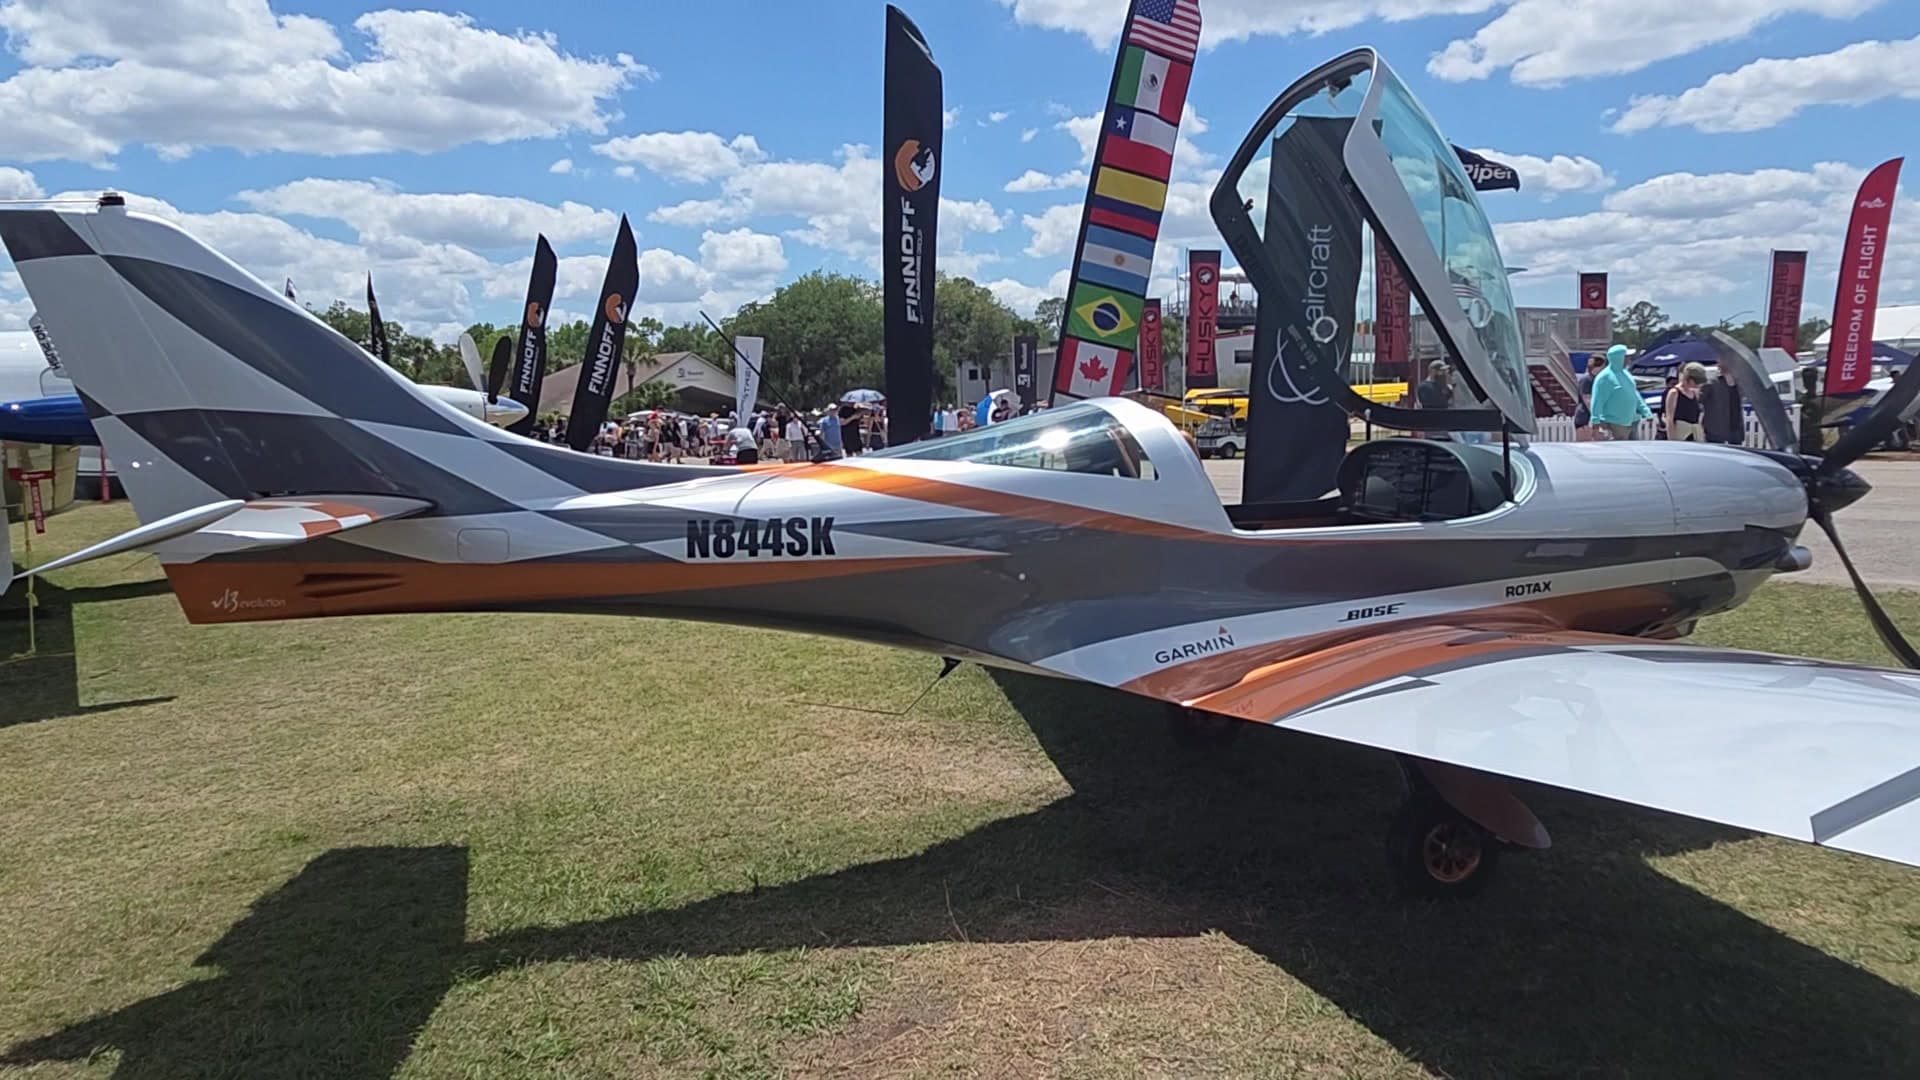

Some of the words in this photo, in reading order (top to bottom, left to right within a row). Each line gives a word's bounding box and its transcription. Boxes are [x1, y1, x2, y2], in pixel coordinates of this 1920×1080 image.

[1463, 164, 1513, 184] Piper
[900, 196, 920, 323] FINNOFF
[1301, 224, 1333, 321] aircraft
[1857, 224, 1878, 280] FLIGHT
[1853, 284, 1868, 305] OF
[520, 328, 537, 394] FINNOFF
[588, 321, 616, 395] FINNOFF
[1144, 325, 1158, 387] HUSKY
[1194, 291, 1214, 375] HUSKY
[1841, 309, 1865, 381] FREEDOM
[686, 516, 836, 559] N844SK
[1338, 602, 1406, 623] BOSE
[1505, 580, 1552, 598] ROTAX
[1154, 633, 1236, 664] GARMIN
